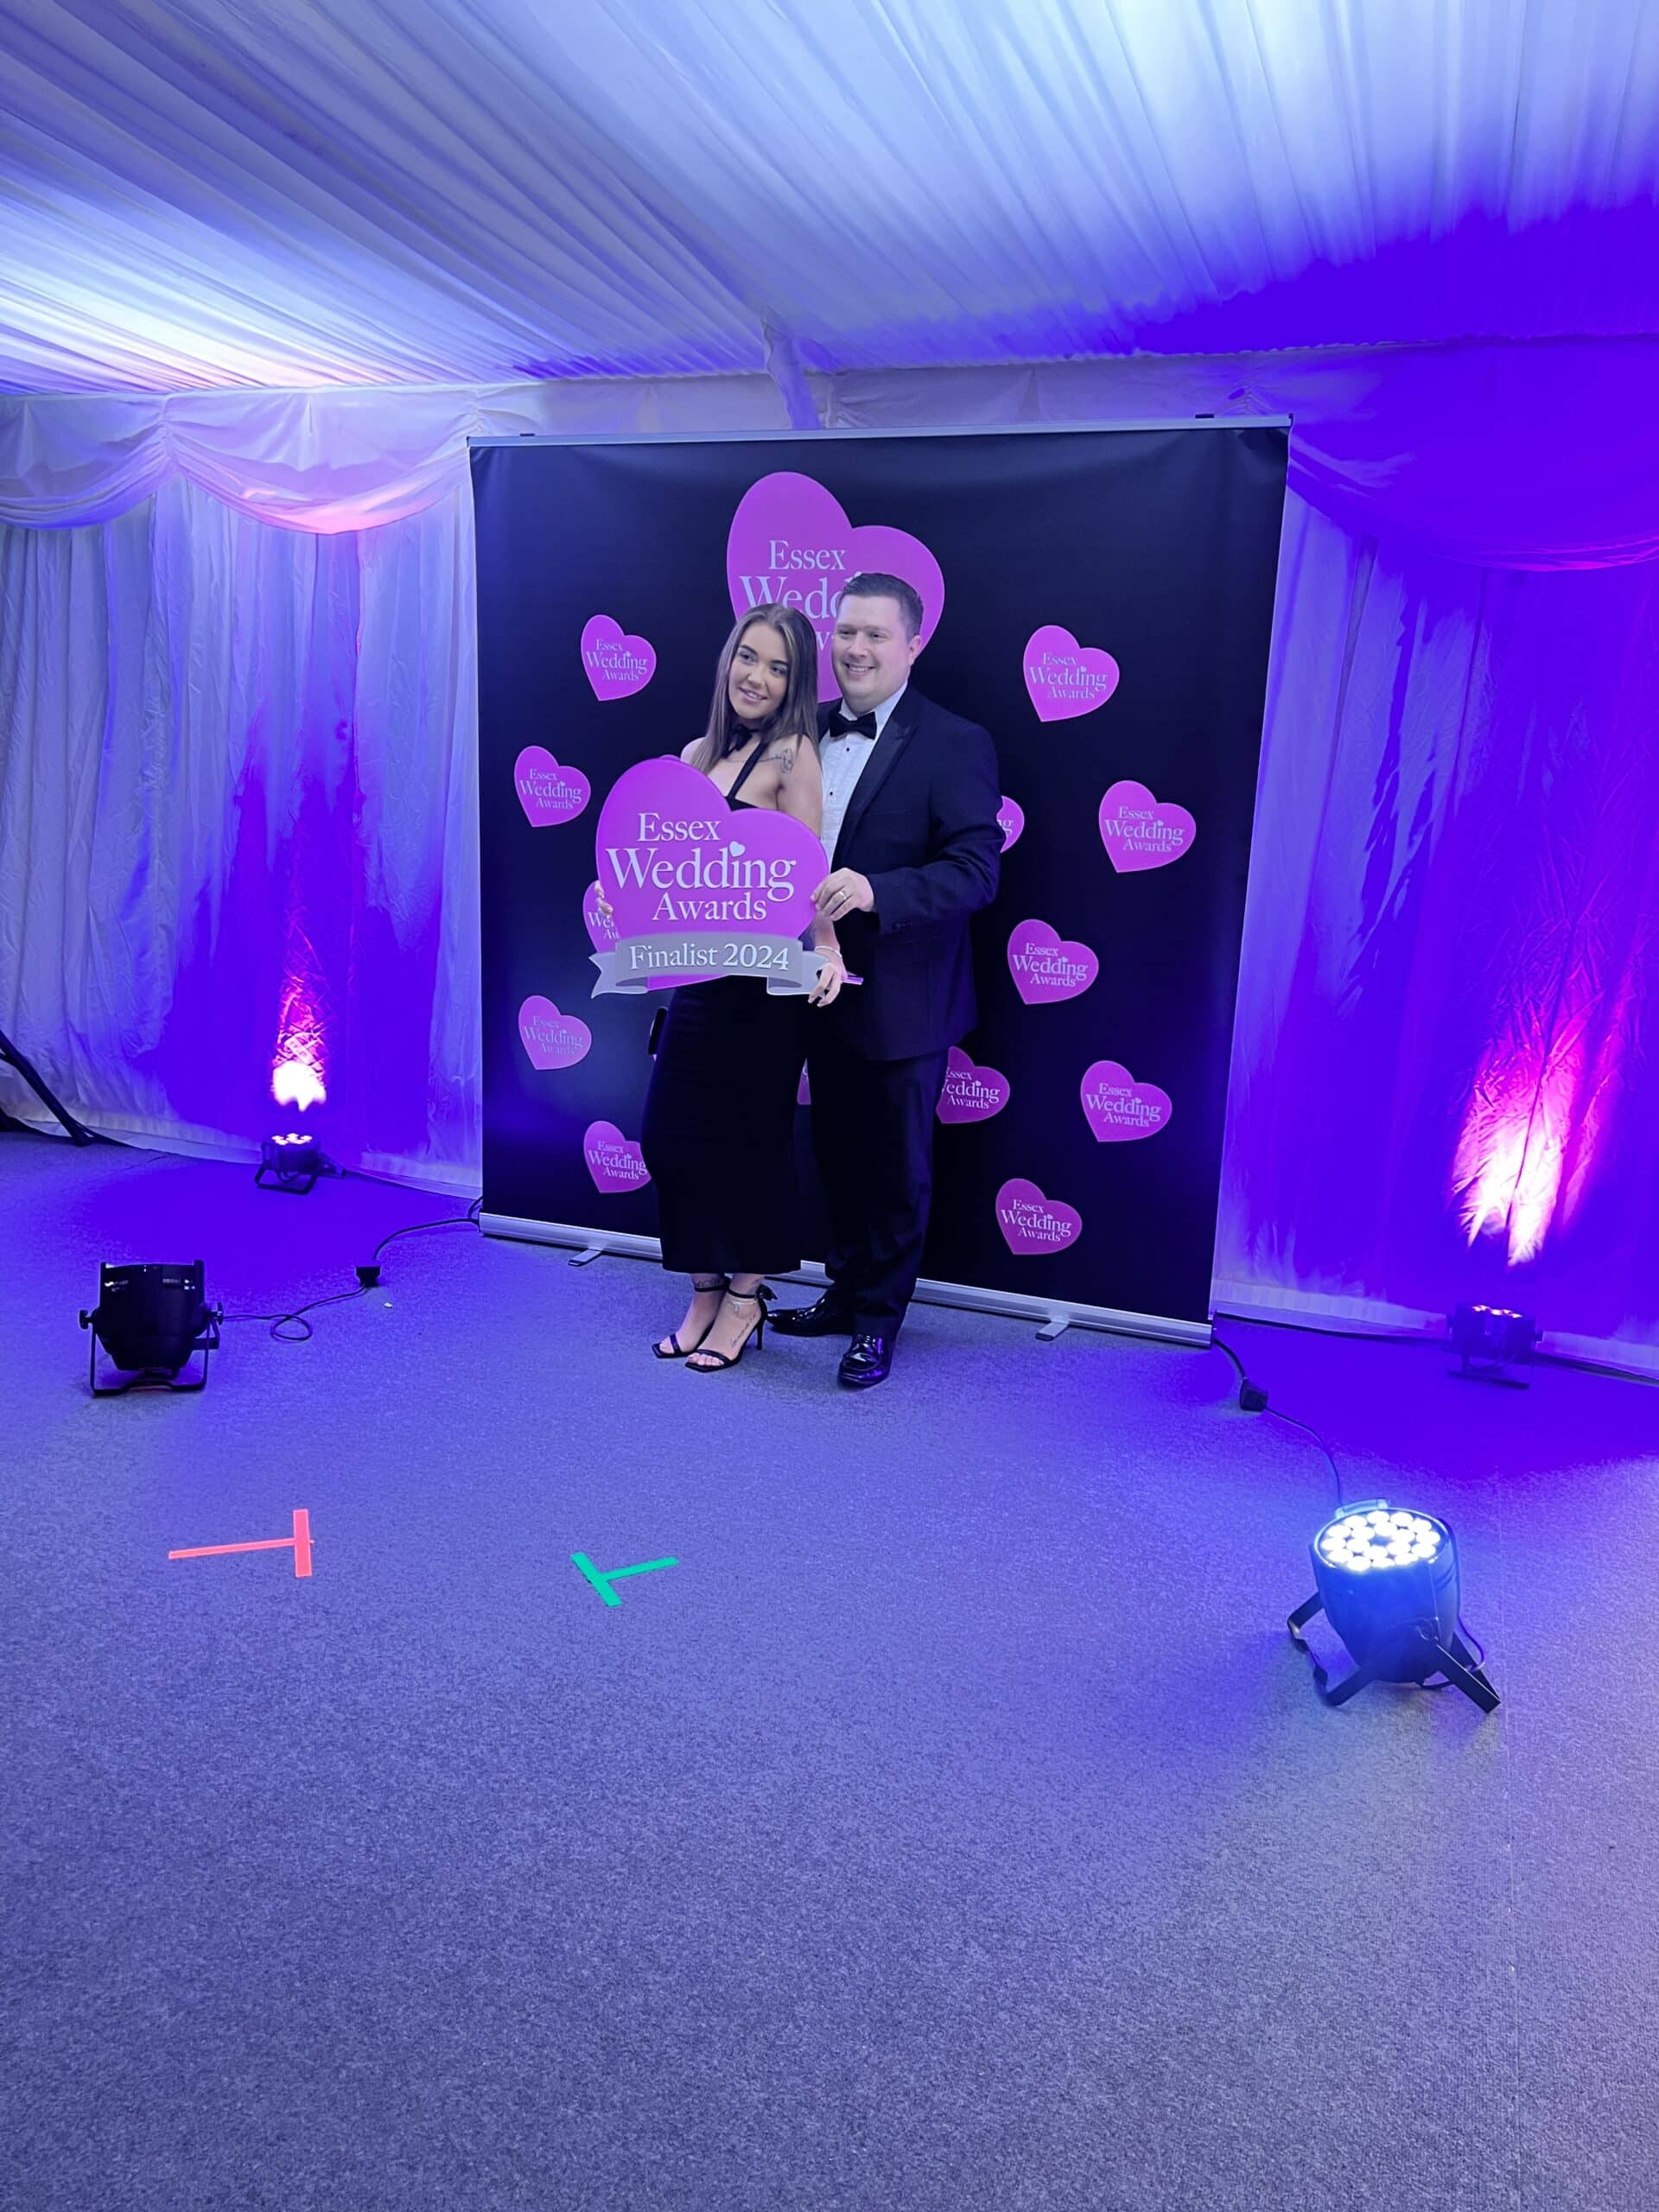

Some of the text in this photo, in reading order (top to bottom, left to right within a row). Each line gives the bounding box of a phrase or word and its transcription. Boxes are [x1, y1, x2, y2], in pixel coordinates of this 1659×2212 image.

[768, 539, 846, 570] Essex
[596, 639, 623, 651] Essex
[586, 651, 648, 675] Wedding
[1043, 652, 1077, 665] Essex
[602, 669, 639, 681] Awards
[1030, 665, 1108, 692] Wedding
[1047, 685, 1095, 699] Awards
[530, 768, 557, 781] Essex
[519, 779, 582, 804] Wedding
[537, 797, 574, 809] Awards
[1119, 805, 1154, 820] Essex
[637, 812, 721, 842] Essex
[1104, 818, 1185, 846] Wedding
[1122, 838, 1172, 852] Awards
[605, 841, 797, 902] Wedding
[652, 892, 767, 920] Awards
[629, 943, 789, 970] Finalist 2024
[1025, 942, 1058, 957] Essex
[1013, 954, 1088, 982] Wedding
[1029, 973, 1077, 987] Awards
[1098, 1082, 1133, 1097] Essex
[947, 1095, 989, 1109] Awards
[1085, 1093, 1161, 1122] Wedding
[1103, 1112, 1149, 1128] Awards
[598, 1141, 624, 1154] Essex
[588, 1150, 647, 1175] Wedding
[603, 1166, 639, 1180] Awards
[1013, 1198, 1044, 1214] Essex
[1001, 1209, 1071, 1237] Wedding
[1018, 1227, 1061, 1242] Awards
